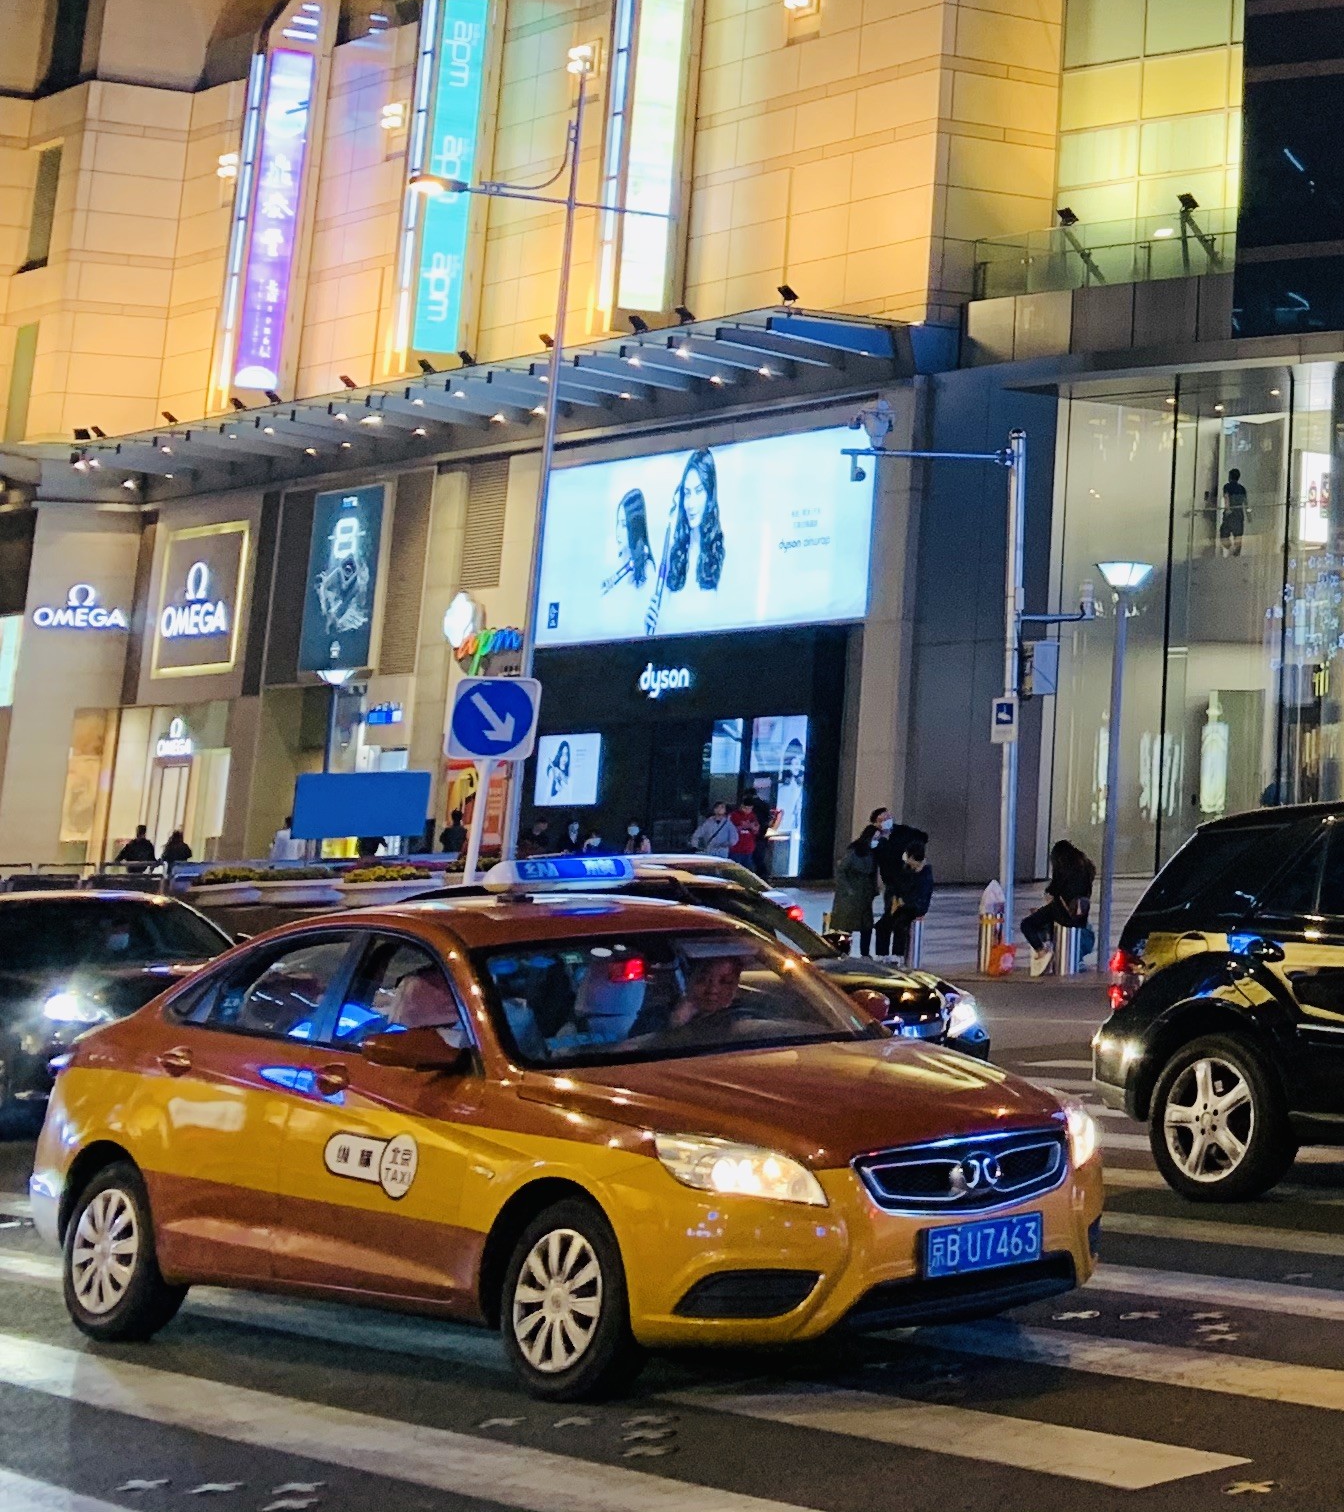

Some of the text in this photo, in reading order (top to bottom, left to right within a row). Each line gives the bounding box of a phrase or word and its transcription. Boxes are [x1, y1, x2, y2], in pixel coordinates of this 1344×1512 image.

[444, 19, 475, 89] apm
[419, 252, 452, 324] apm
[33, 606, 128, 630] OMEGA
[161, 601, 228, 638] OMEGA
[455, 626, 523, 676] apm
[639, 662, 690, 699] dyson
[156, 738, 193, 757] OMEGA
[389, 1146, 413, 1167] 北京
[384, 1167, 412, 1186] TAXI
